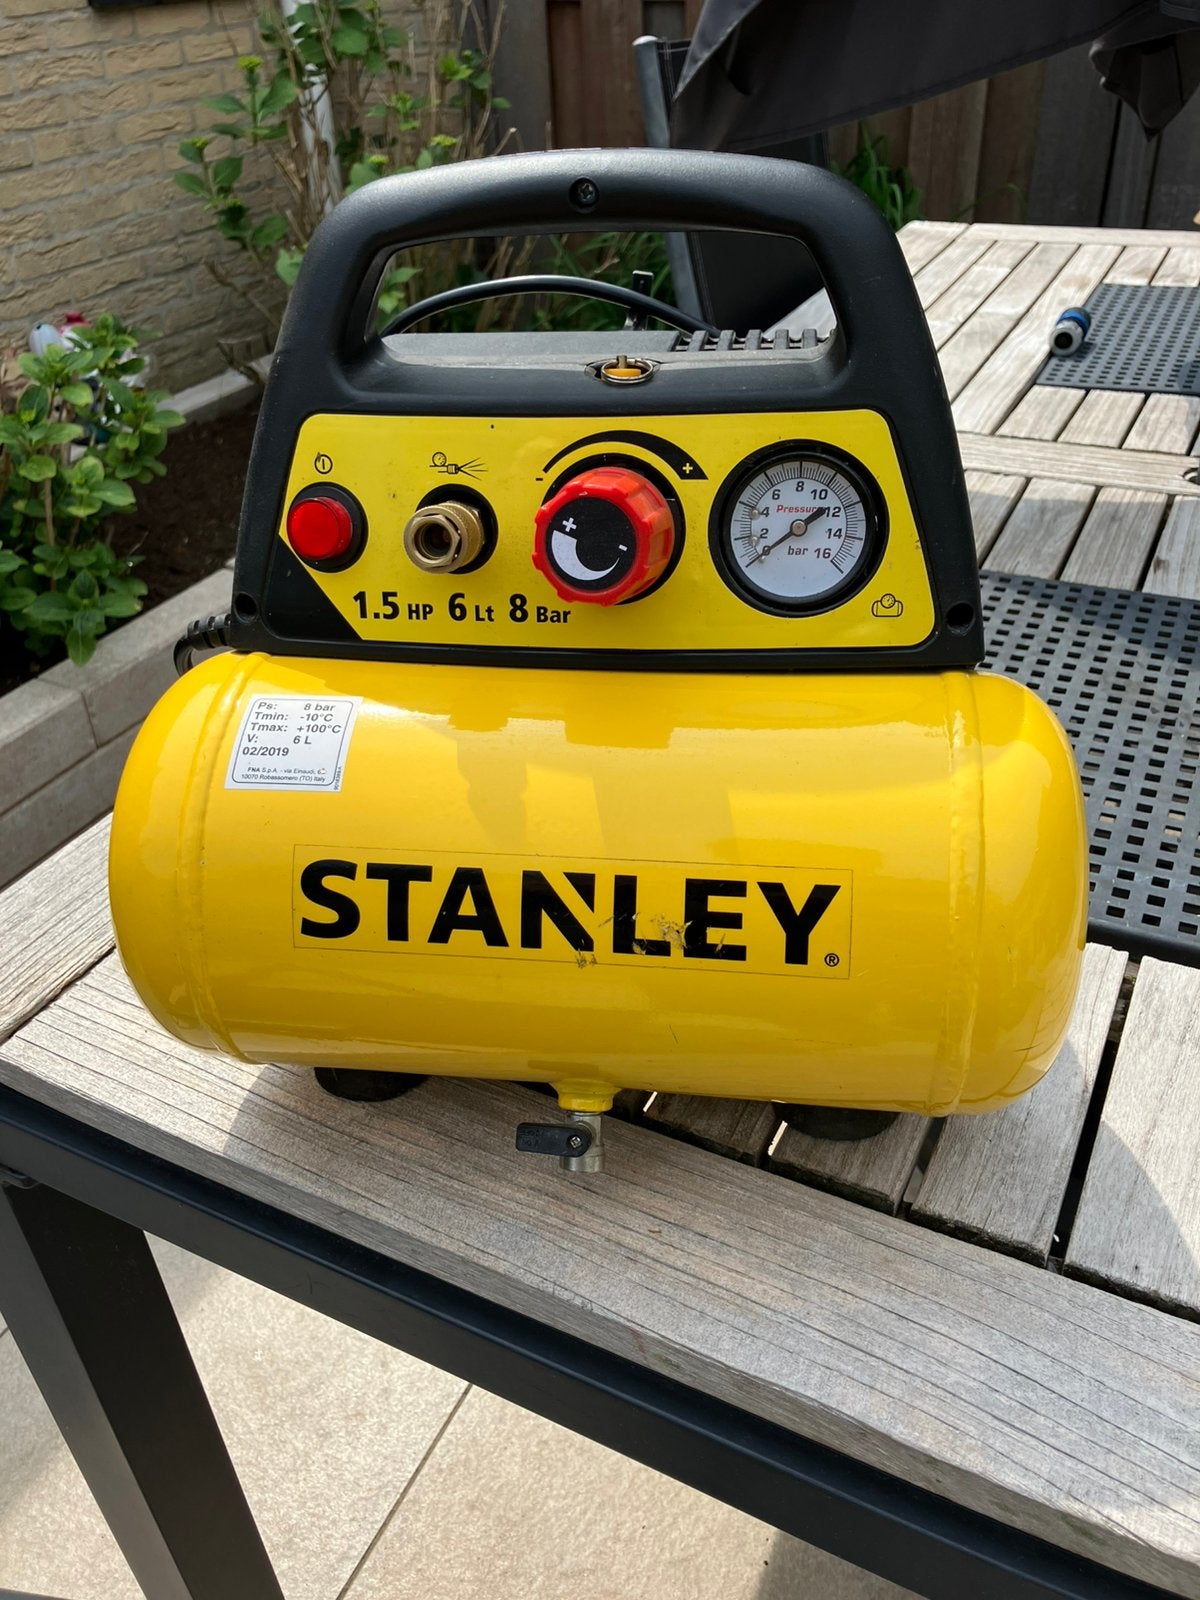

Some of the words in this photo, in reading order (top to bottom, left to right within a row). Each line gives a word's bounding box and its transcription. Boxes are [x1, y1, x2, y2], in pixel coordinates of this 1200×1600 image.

[796, 481, 804, 492] 8
[772, 489, 781, 500] 6
[811, 489, 828, 500] 10
[761, 507, 770, 518] 4
[776, 505, 821, 513] Pressur
[825, 506, 842, 518] 12
[760, 528, 769, 539] 2
[825, 528, 842, 539] 14
[788, 545, 809, 556] bar
[814, 548, 832, 558] 16
[353, 591, 400, 620] 1.5
[407, 603, 434, 620] HP
[448, 592, 468, 622] 6
[475, 605, 495, 622] Lt
[509, 593, 528, 623] 8
[536, 606, 571, 624] Bar
[258, 702, 278, 710] Ps:
[304, 703, 312, 711] 8
[314, 704, 336, 712] bar
[254, 712, 288, 721] Tmin:
[300, 713, 334, 722] -10°C
[250, 722, 288, 732] Tmax:
[296, 724, 342, 734] +100°C
[247, 734, 258, 743] V:
[293, 736, 300, 744] 6
[304, 736, 312, 744] L
[242, 746, 290, 756] 02/2019
